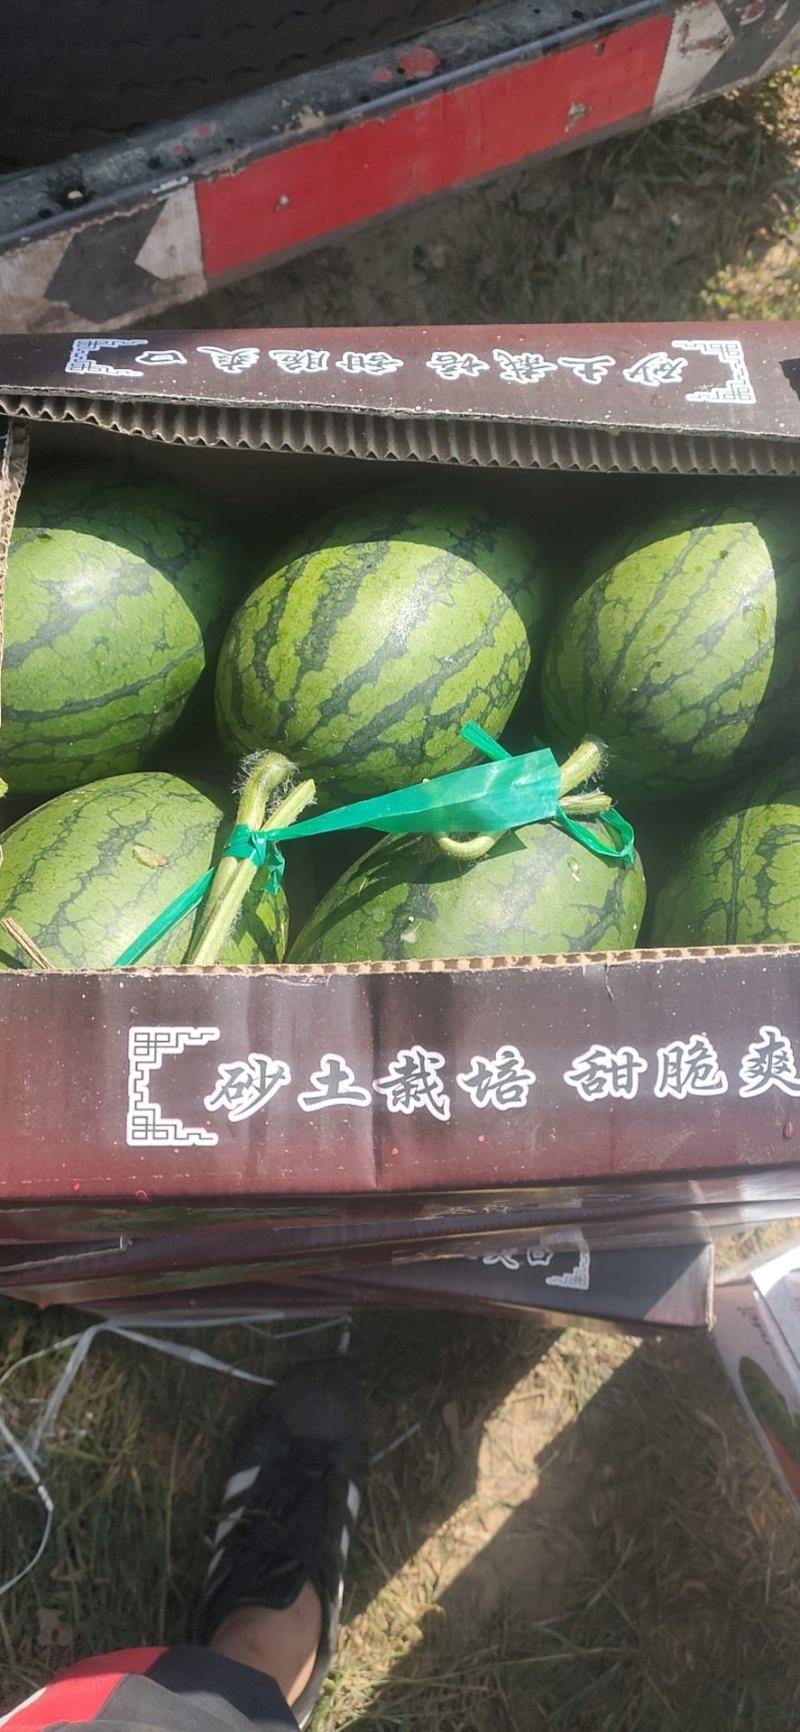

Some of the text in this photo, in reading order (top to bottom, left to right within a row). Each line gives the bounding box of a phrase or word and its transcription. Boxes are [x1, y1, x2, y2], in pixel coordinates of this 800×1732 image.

[135, 346, 688, 386] 砂土栽培 甜脆爽口
[203, 1025, 800, 1121] 砂土栽培 甜脆爽
